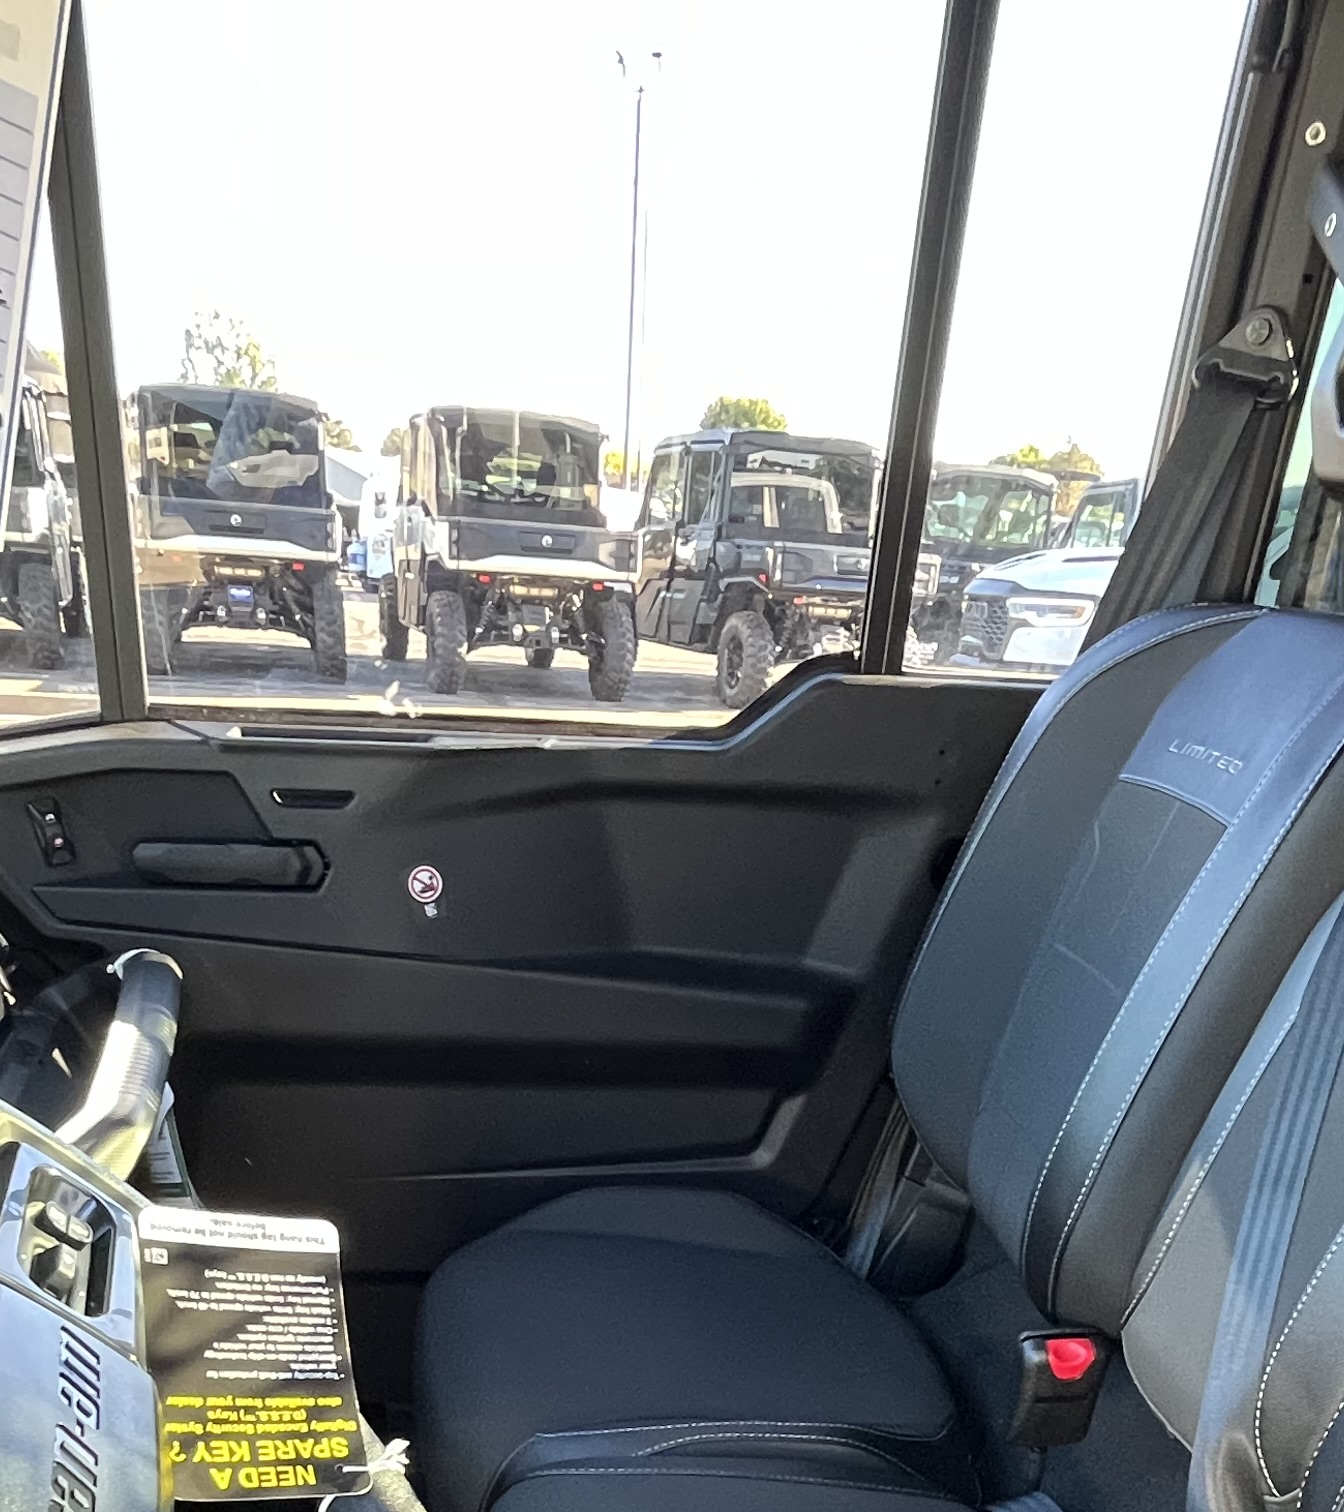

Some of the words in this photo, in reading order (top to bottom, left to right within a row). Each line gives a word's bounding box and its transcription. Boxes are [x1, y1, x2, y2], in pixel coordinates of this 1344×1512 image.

[1168, 738, 1244, 776] LIMITED
[208, 1229, 225, 1238] not
[227, 1230, 258, 1241] should
[305, 1237, 325, 1246] This
[205, 1421, 255, 1435] Security
[192, 1440, 252, 1463] KEY
[256, 1437, 350, 1462] SPARE
[209, 1467, 233, 1490] A
[238, 1464, 317, 1489] NEED
